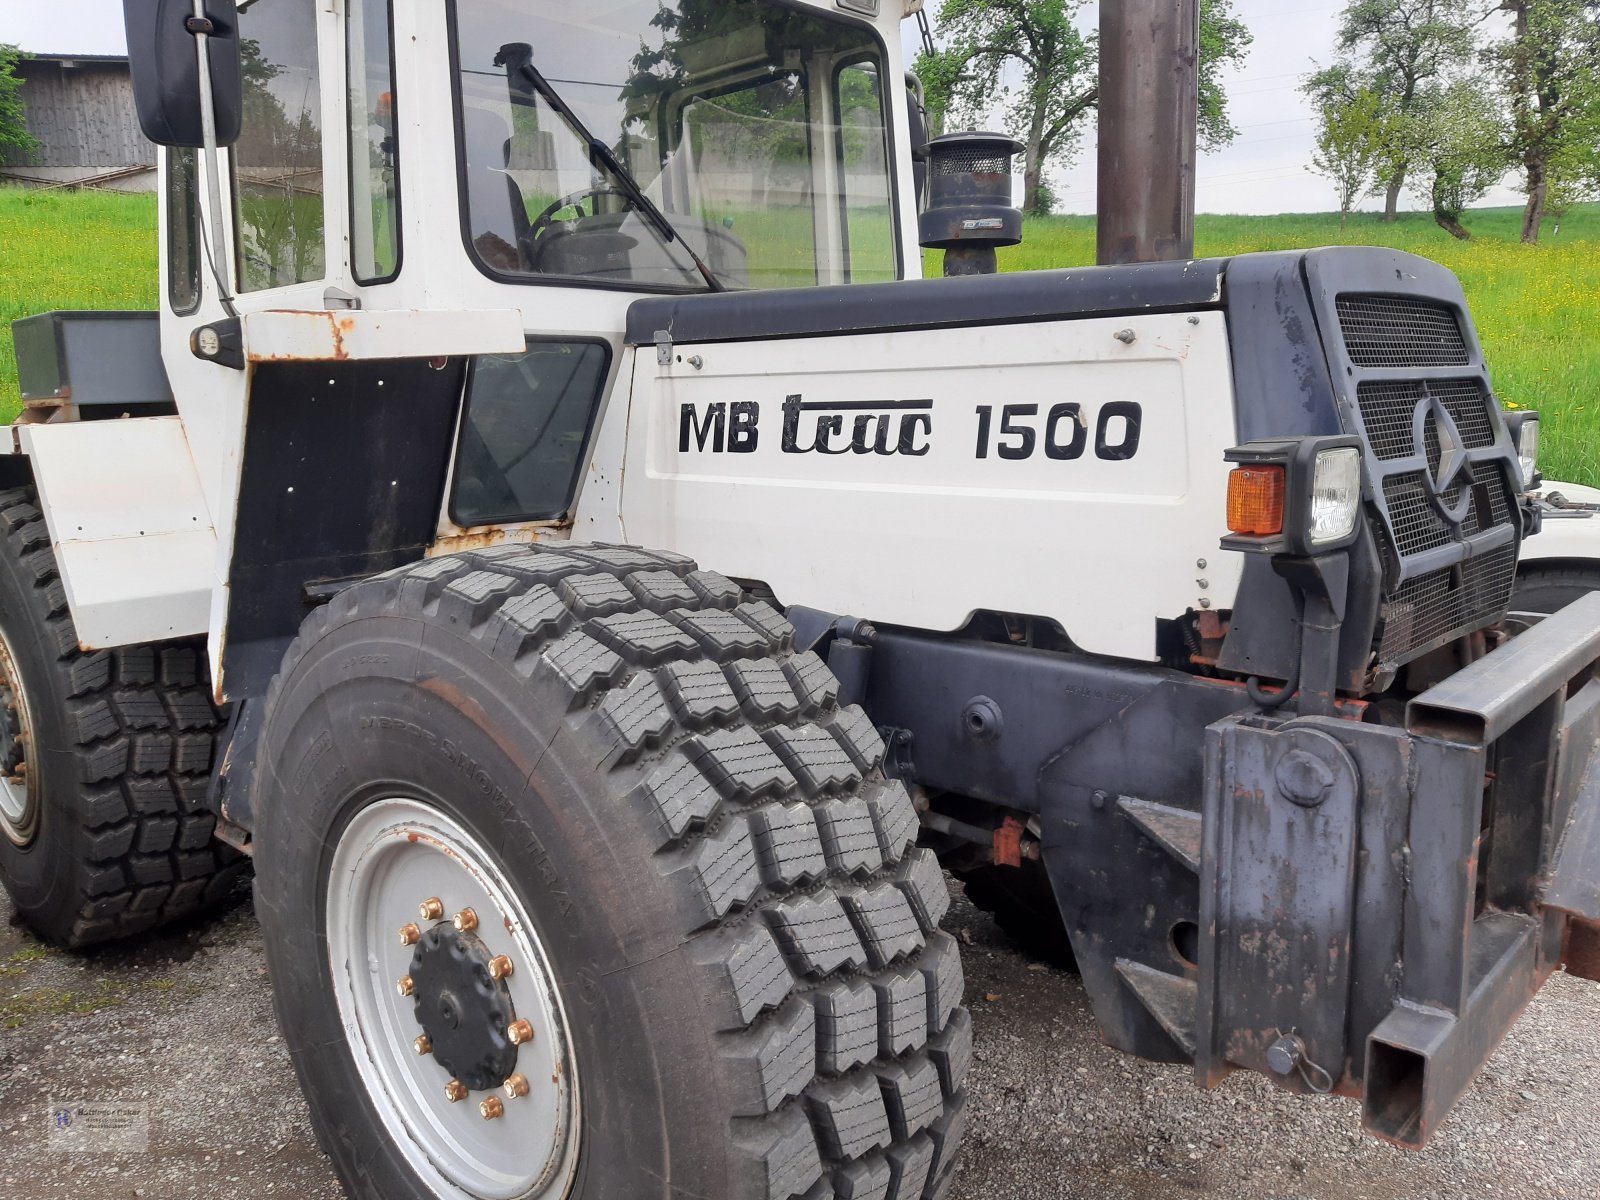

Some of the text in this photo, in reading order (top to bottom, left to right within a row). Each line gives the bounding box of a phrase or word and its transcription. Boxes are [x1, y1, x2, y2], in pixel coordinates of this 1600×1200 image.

[678, 394, 1142, 461] MB trac 1500
